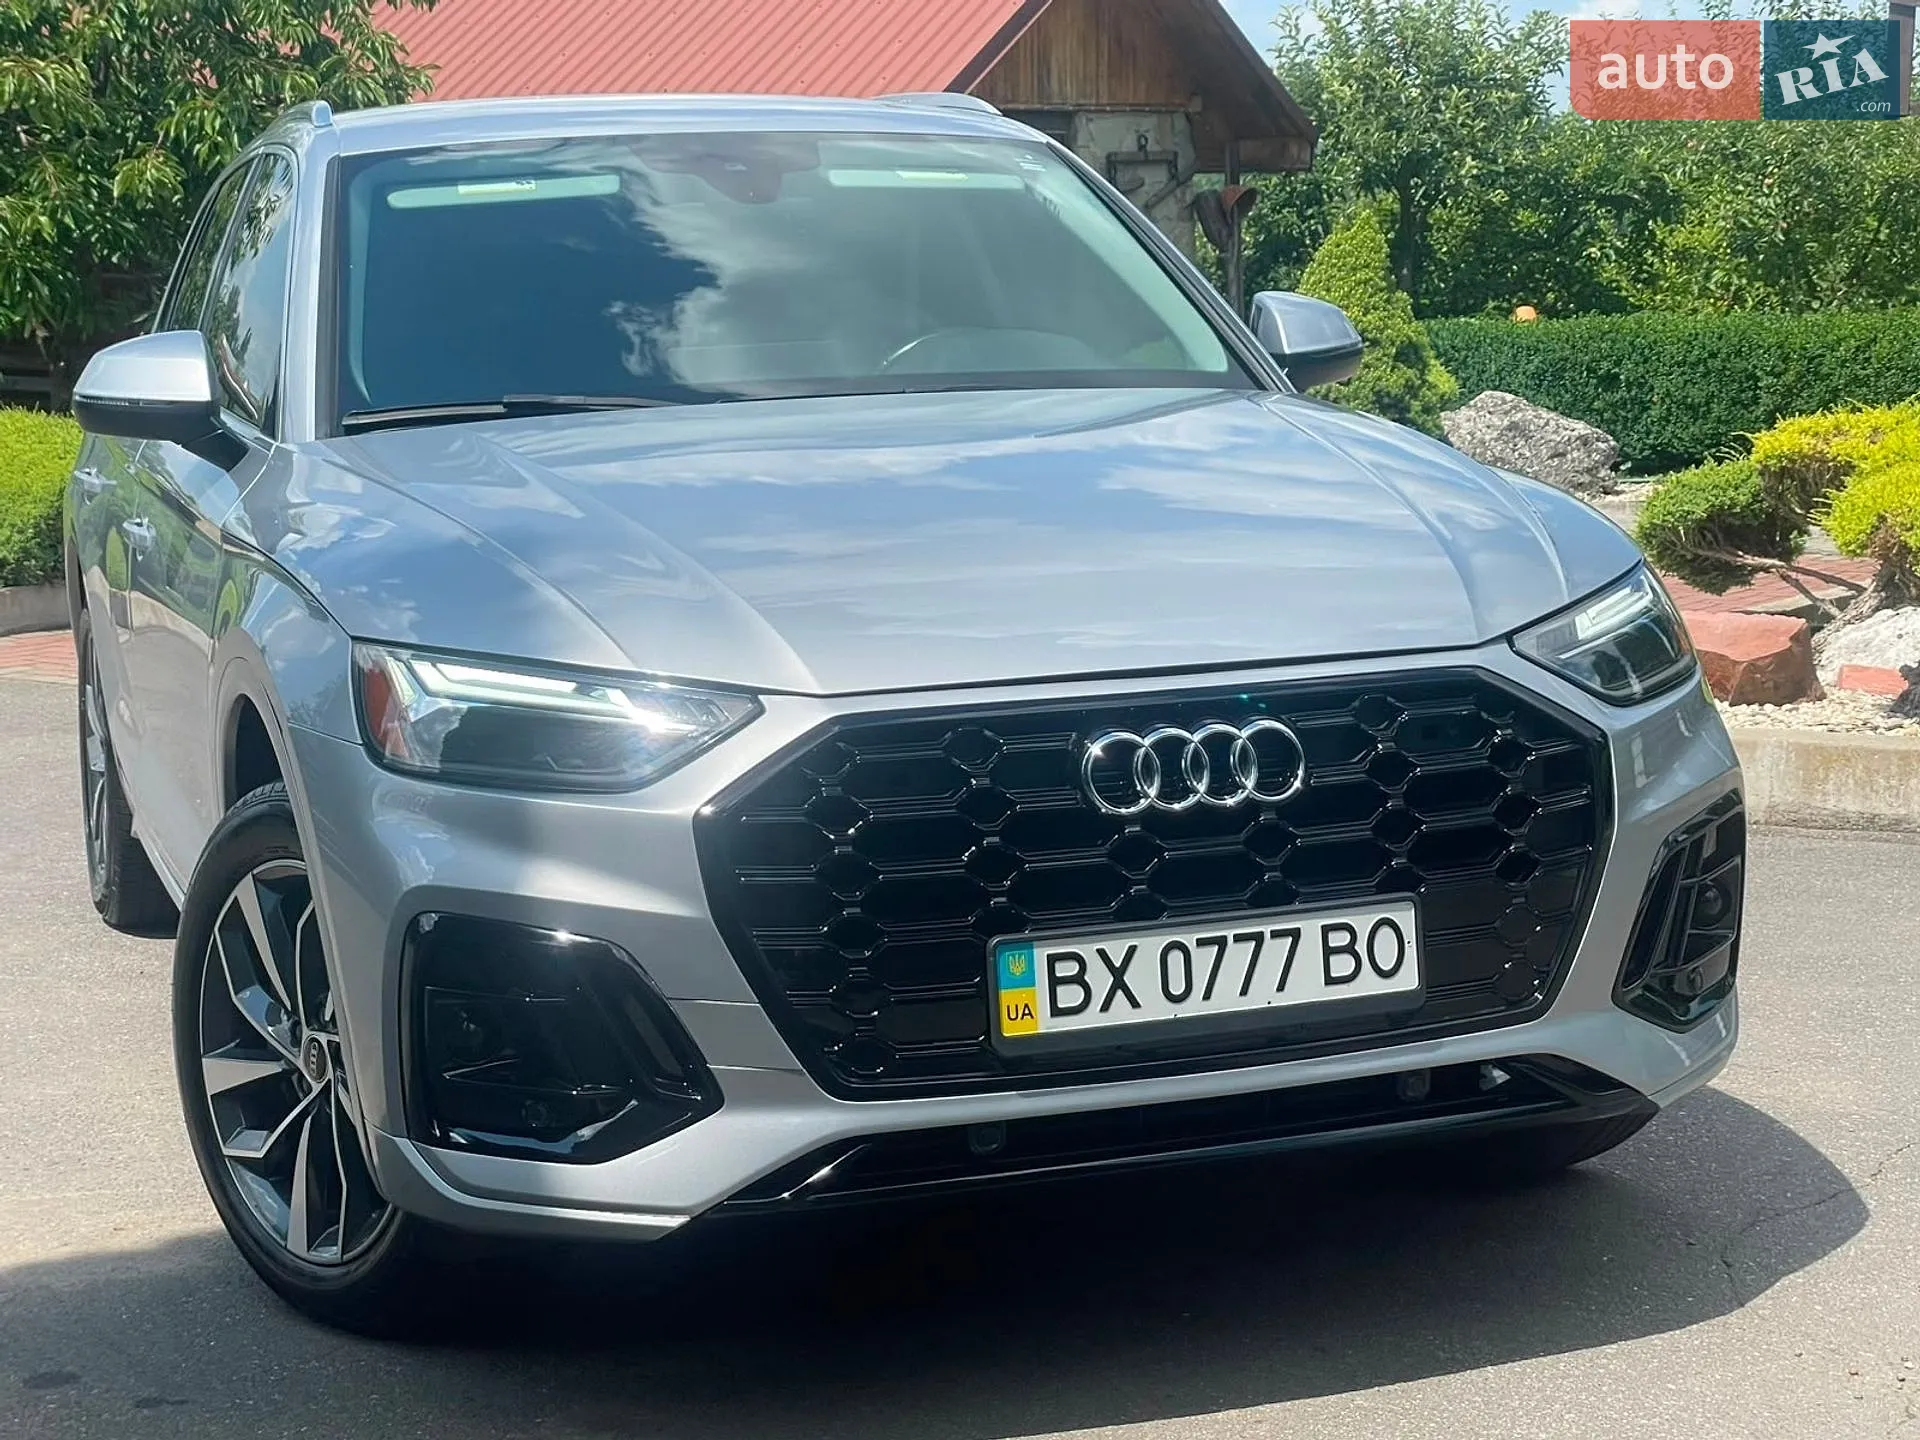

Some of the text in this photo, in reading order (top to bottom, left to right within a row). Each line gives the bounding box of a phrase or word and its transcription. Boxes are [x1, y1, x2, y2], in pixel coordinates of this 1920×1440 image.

[1046, 916, 1406, 1018] BX 0777 BO
[1006, 1004, 1034, 1022] UA
